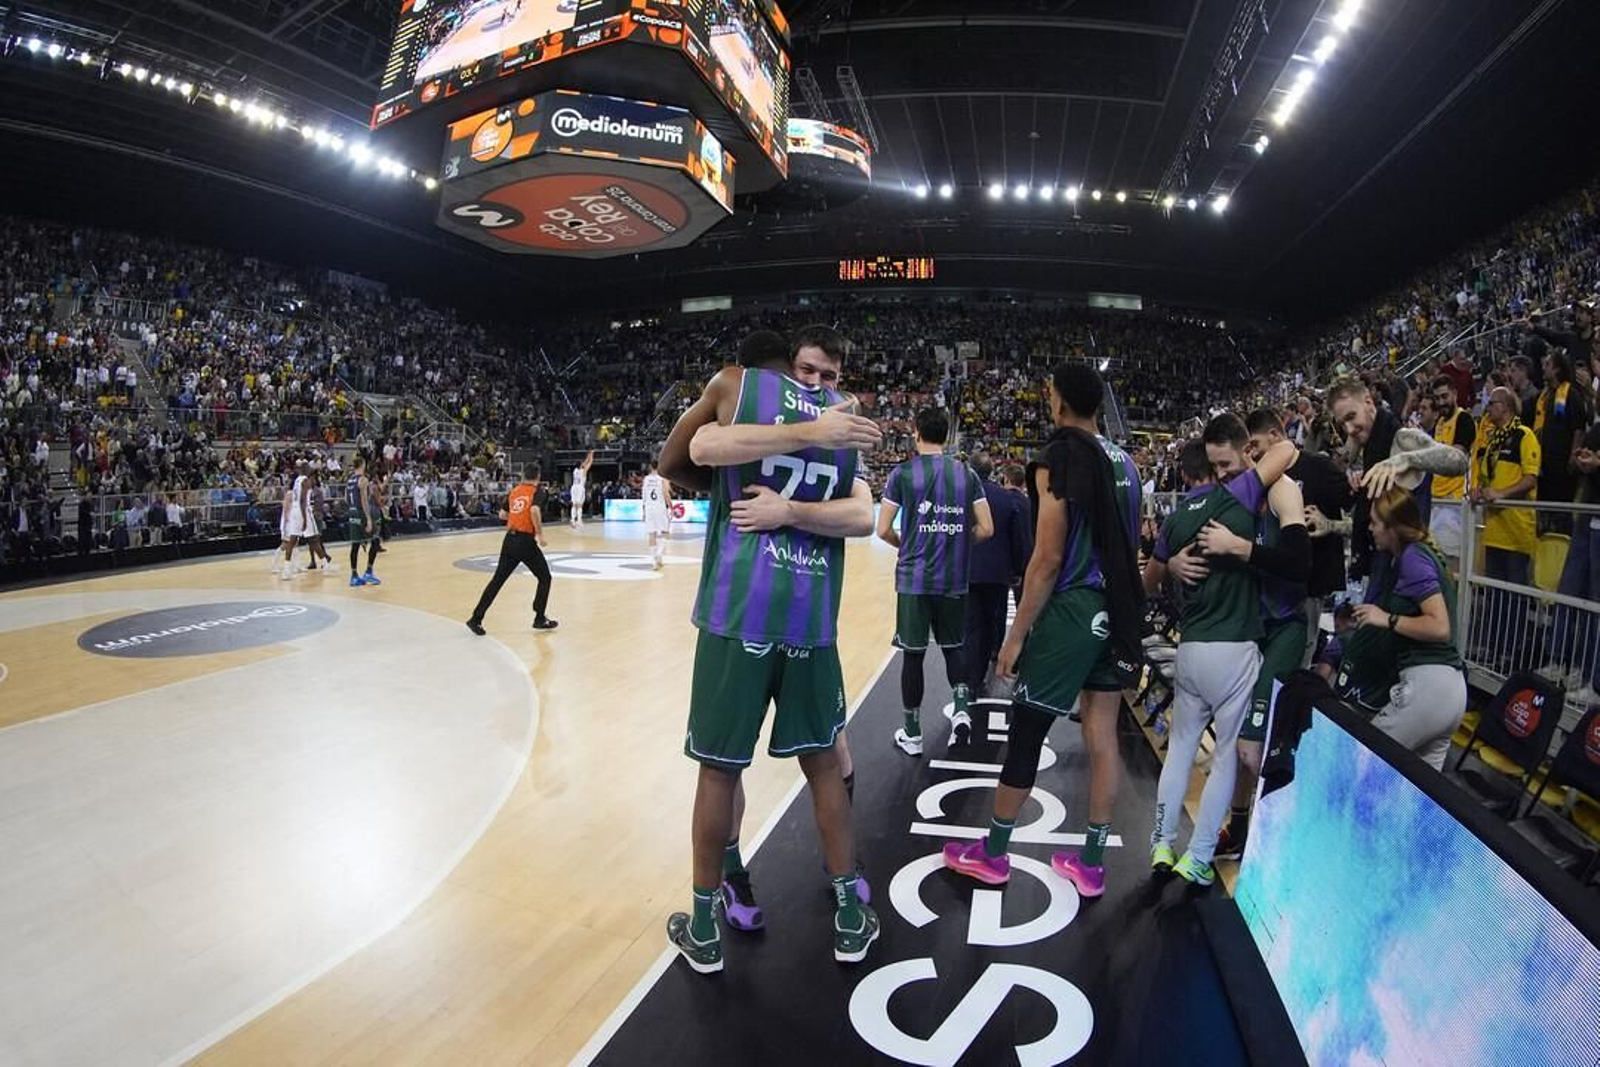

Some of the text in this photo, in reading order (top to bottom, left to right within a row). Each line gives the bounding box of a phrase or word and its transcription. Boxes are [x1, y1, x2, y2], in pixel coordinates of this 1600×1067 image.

[632, 13, 683, 30] #CopaACB
[551, 107, 684, 145] mediolanum
[655, 122, 684, 134] BANCO
[569, 194, 629, 225] Rey
[538, 223, 579, 242] acb
[545, 207, 615, 244] Copa
[649, 488, 659, 501] 6
[932, 504, 965, 516] Unicaja
[919, 519, 964, 536] málaga
